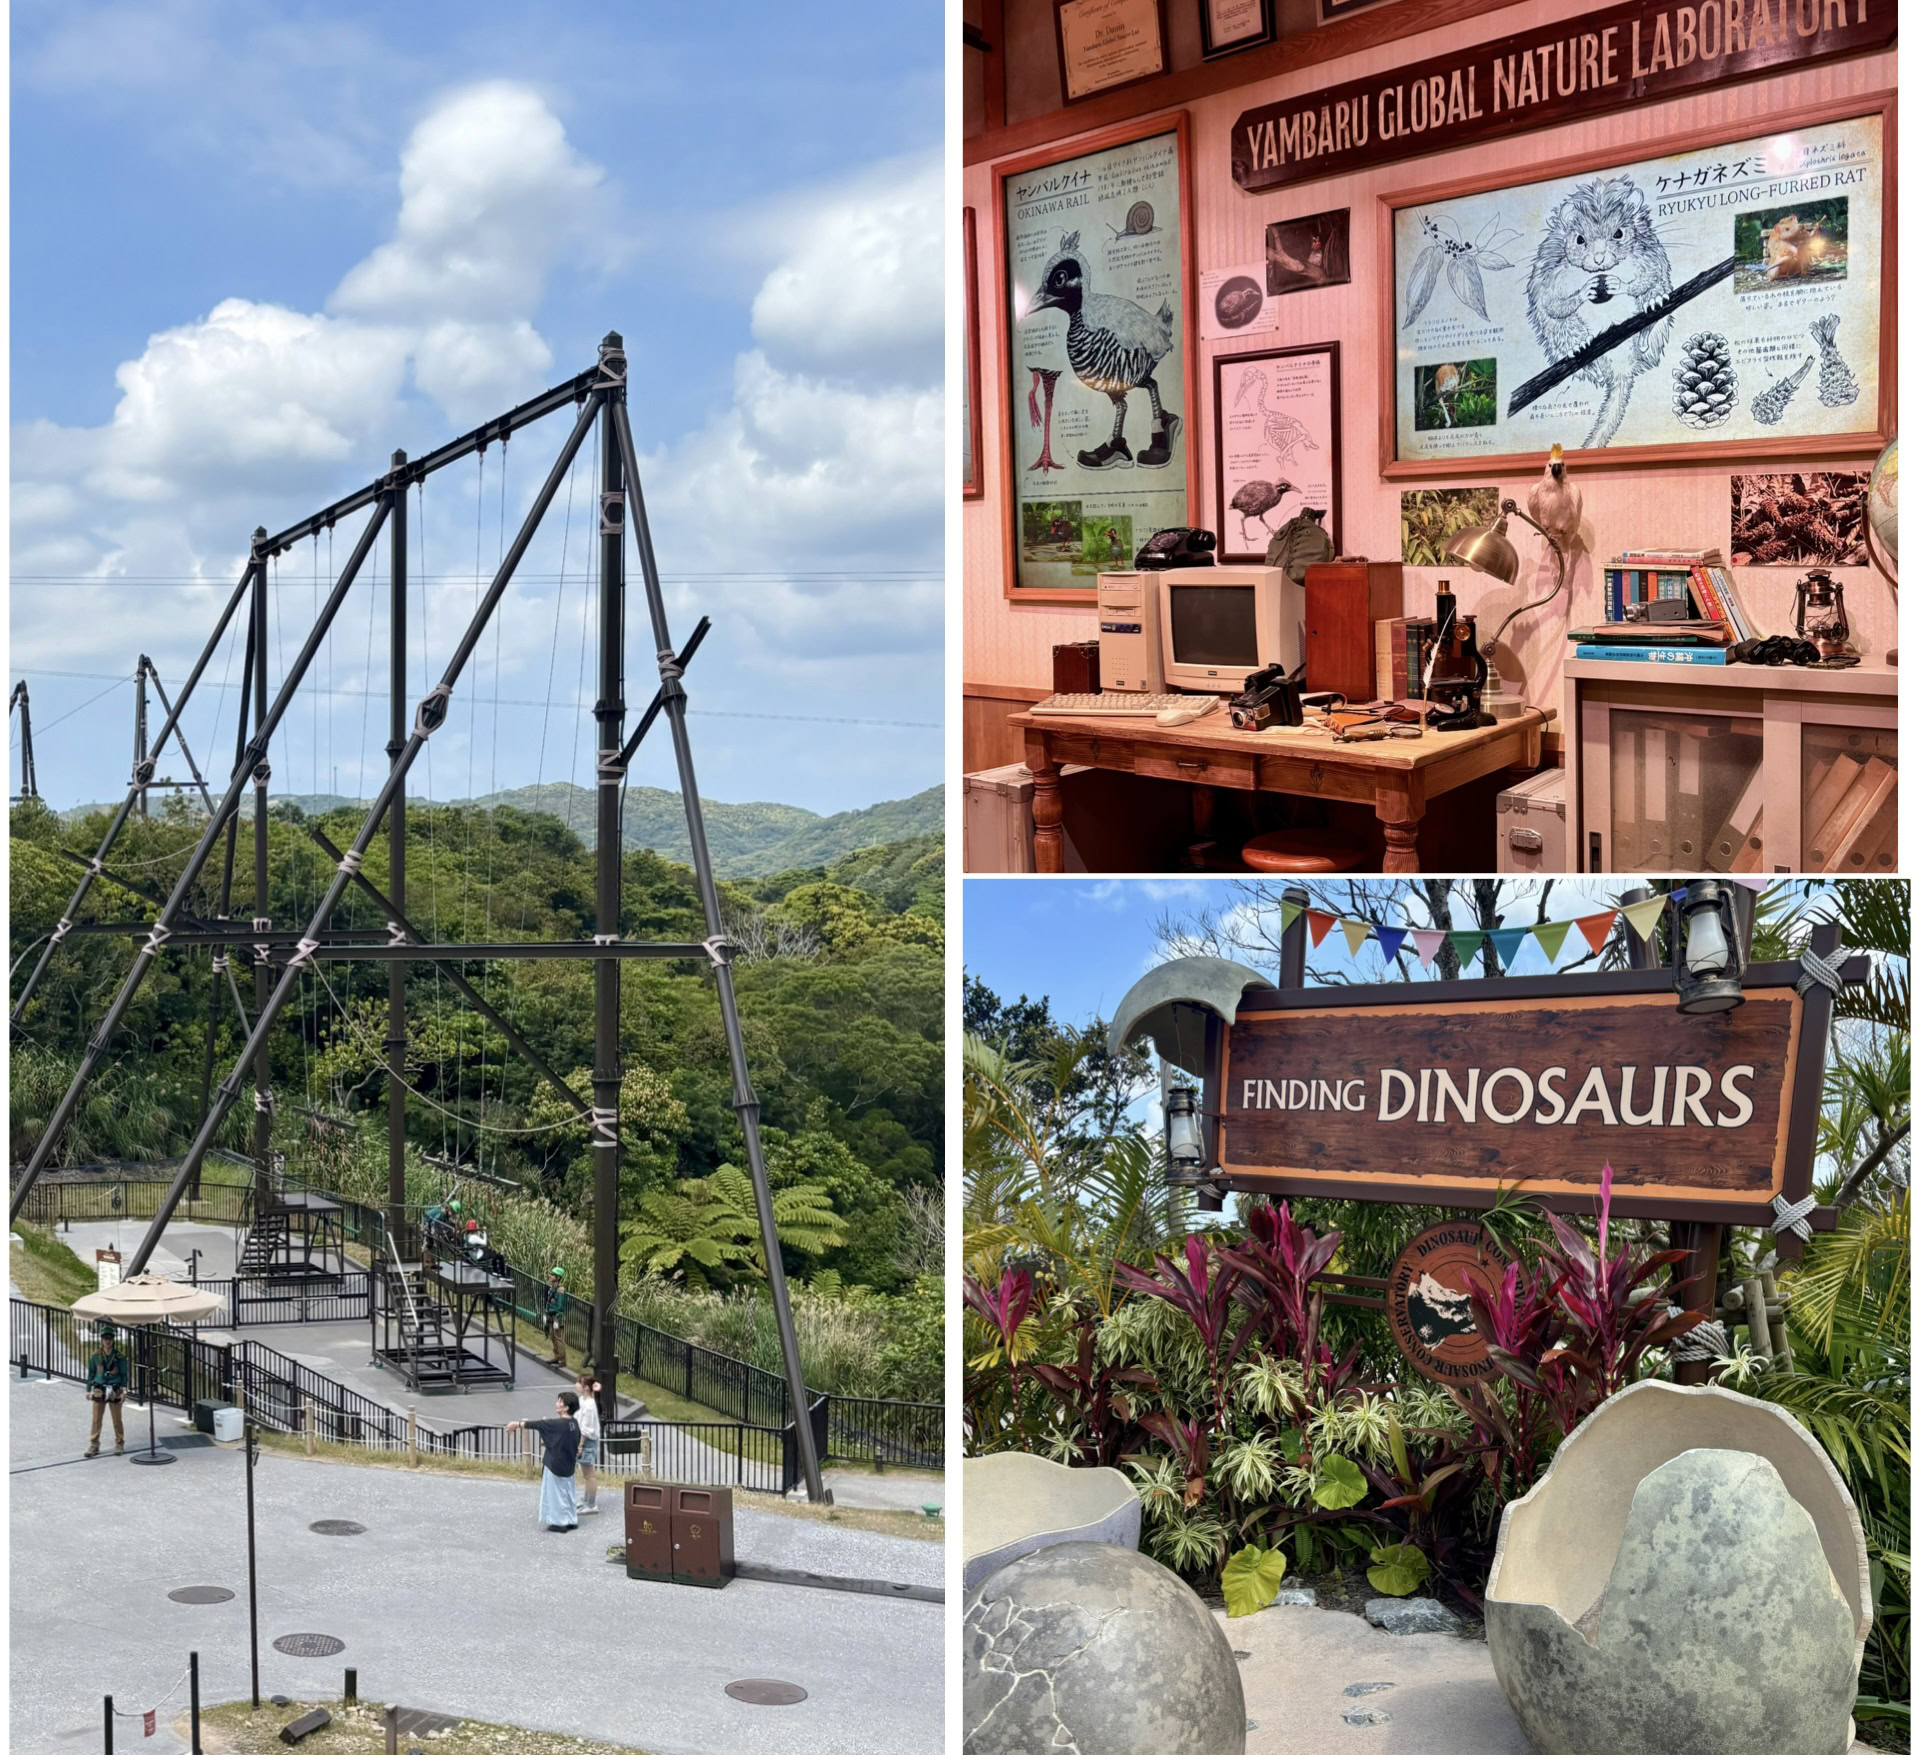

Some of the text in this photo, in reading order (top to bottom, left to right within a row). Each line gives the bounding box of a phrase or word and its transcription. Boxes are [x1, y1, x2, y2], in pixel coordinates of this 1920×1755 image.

[1247, 94, 1369, 171] YAMBARU
[1378, 65, 1483, 141] GLOBAL
[1493, 26, 1618, 111] NATURE
[1016, 169, 1092, 201] ヤンバルクイナ
[1655, 156, 1766, 193] ケナガネズミ
[1658, 168, 1867, 217] RYUKYU LONG-FURRED RAT
[1018, 194, 1089, 220] OKINAWA RAIL
[1648, 649, 1693, 664] 沖縄の生物
[1242, 1064, 1756, 1129] FINDING DINOSAURS
[1395, 1262, 1496, 1378] INOSAUR CONSERVATORY
